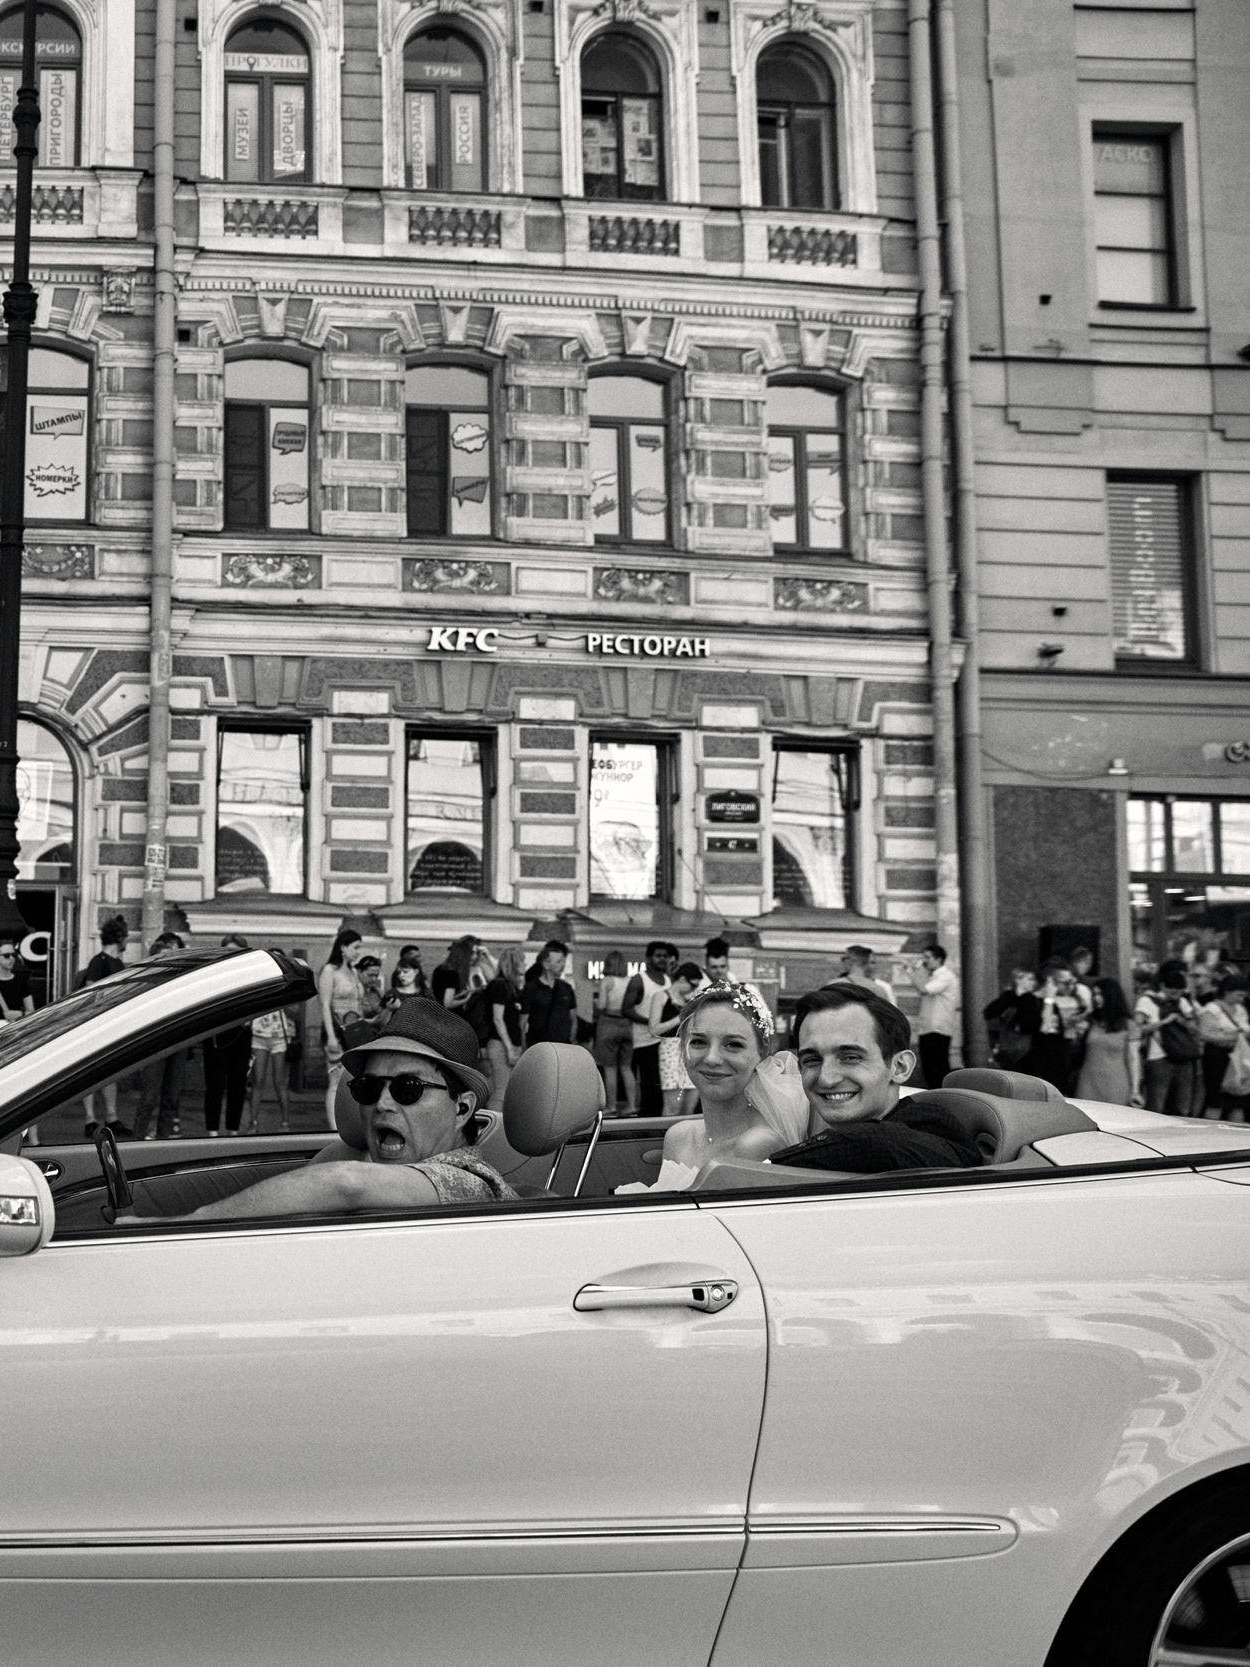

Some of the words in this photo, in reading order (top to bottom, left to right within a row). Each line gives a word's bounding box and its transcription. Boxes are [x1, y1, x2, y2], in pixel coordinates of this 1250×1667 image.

[423, 65, 462, 78] ТУРЫ
[49, 73, 64, 166] ПРИГОРОДЫ
[282, 102, 297, 167] ДВОРЦЫ
[458, 105, 471, 162] РОССИЯ
[34, 411, 83, 431] ШТАМПЫ
[35, 473, 73, 483] НОМЕРКИ
[426, 626, 500, 652] KFC
[587, 632, 711, 657] РЕСТОРАН
